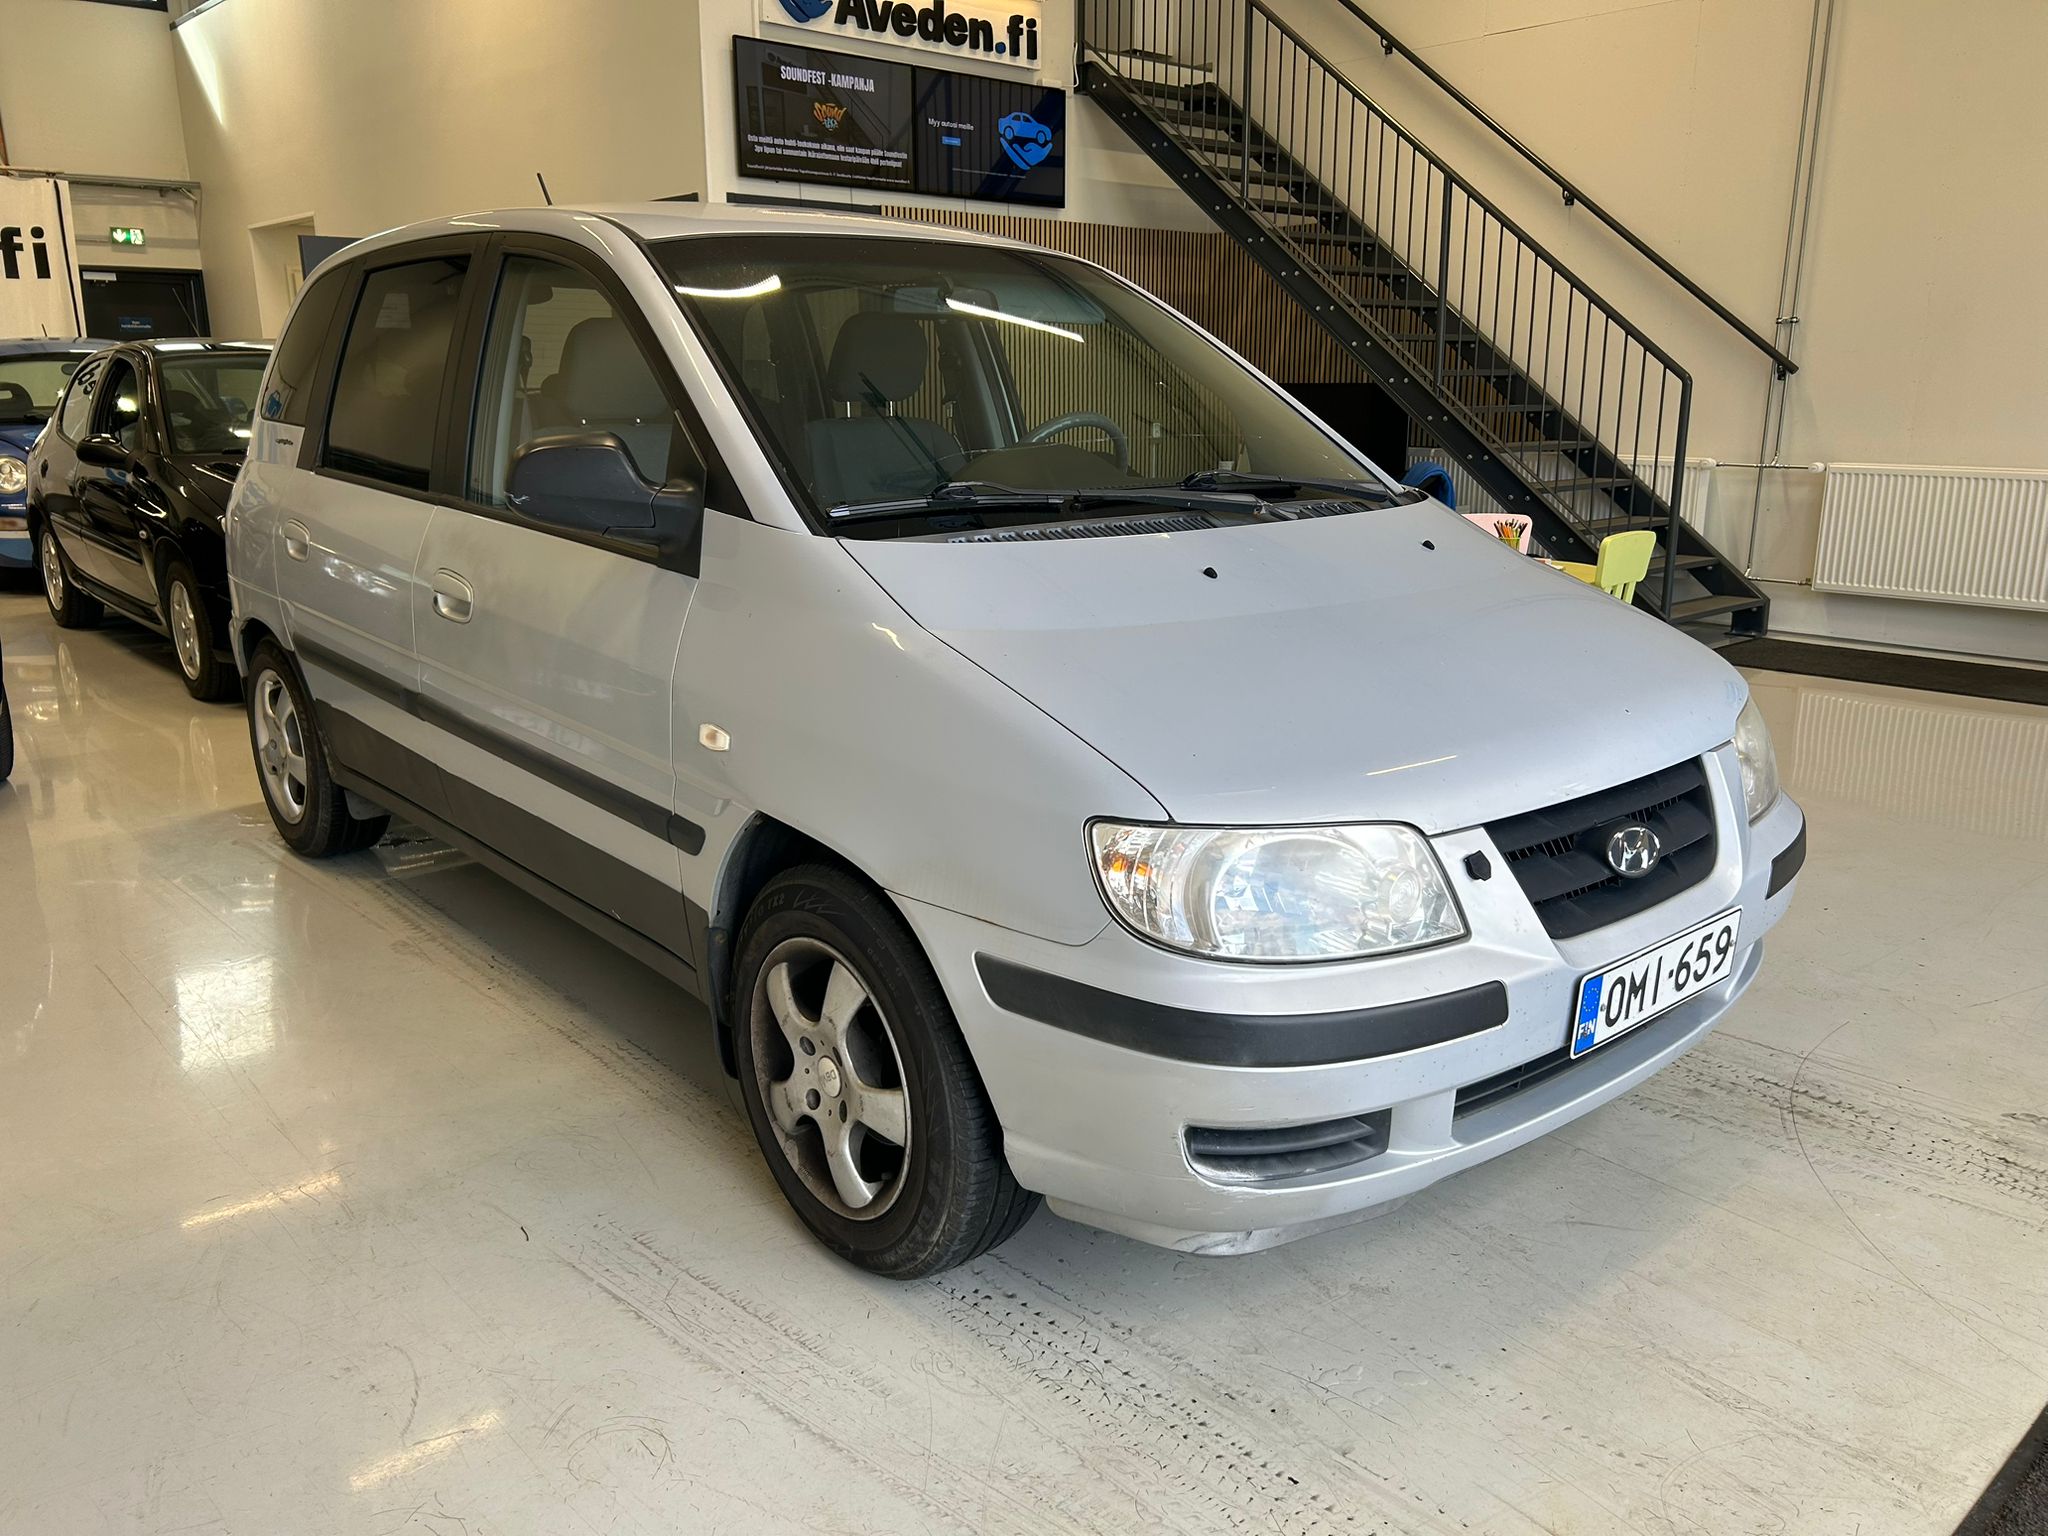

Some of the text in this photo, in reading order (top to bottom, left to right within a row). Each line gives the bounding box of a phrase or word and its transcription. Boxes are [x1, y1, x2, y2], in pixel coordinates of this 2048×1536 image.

[834, 0, 1038, 60] Aveden.fi
[780, 65, 875, 93] SOUNDFEST -KAMPANJA
[928, 118, 941, 128] Myy
[0, 226, 51, 279] fi
[1605, 925, 1732, 1028] OMI-659
[1577, 1019, 1597, 1040] FIN
